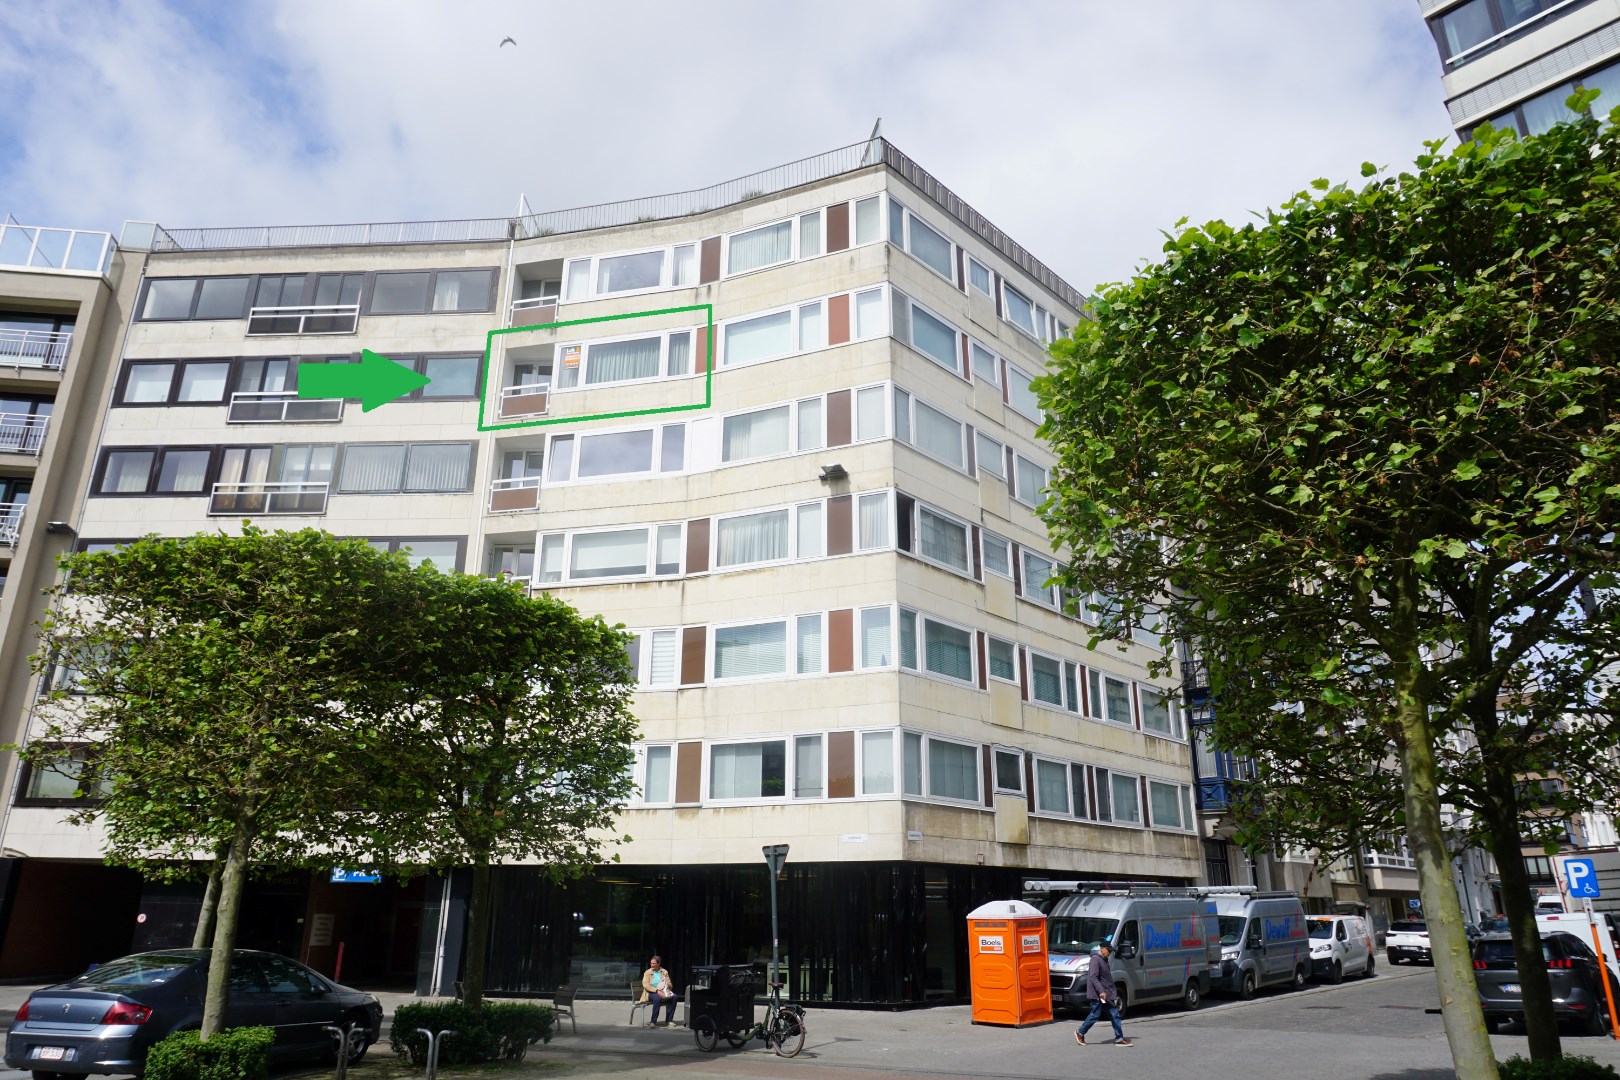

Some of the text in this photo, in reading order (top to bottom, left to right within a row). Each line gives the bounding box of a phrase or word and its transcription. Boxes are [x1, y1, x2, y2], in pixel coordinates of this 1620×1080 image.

[1566, 862, 1589, 889] P
[1145, 922, 1181, 950] Dewulf
[1265, 917, 1290, 940] Dewulf
[1023, 938, 1039, 946] Boels
